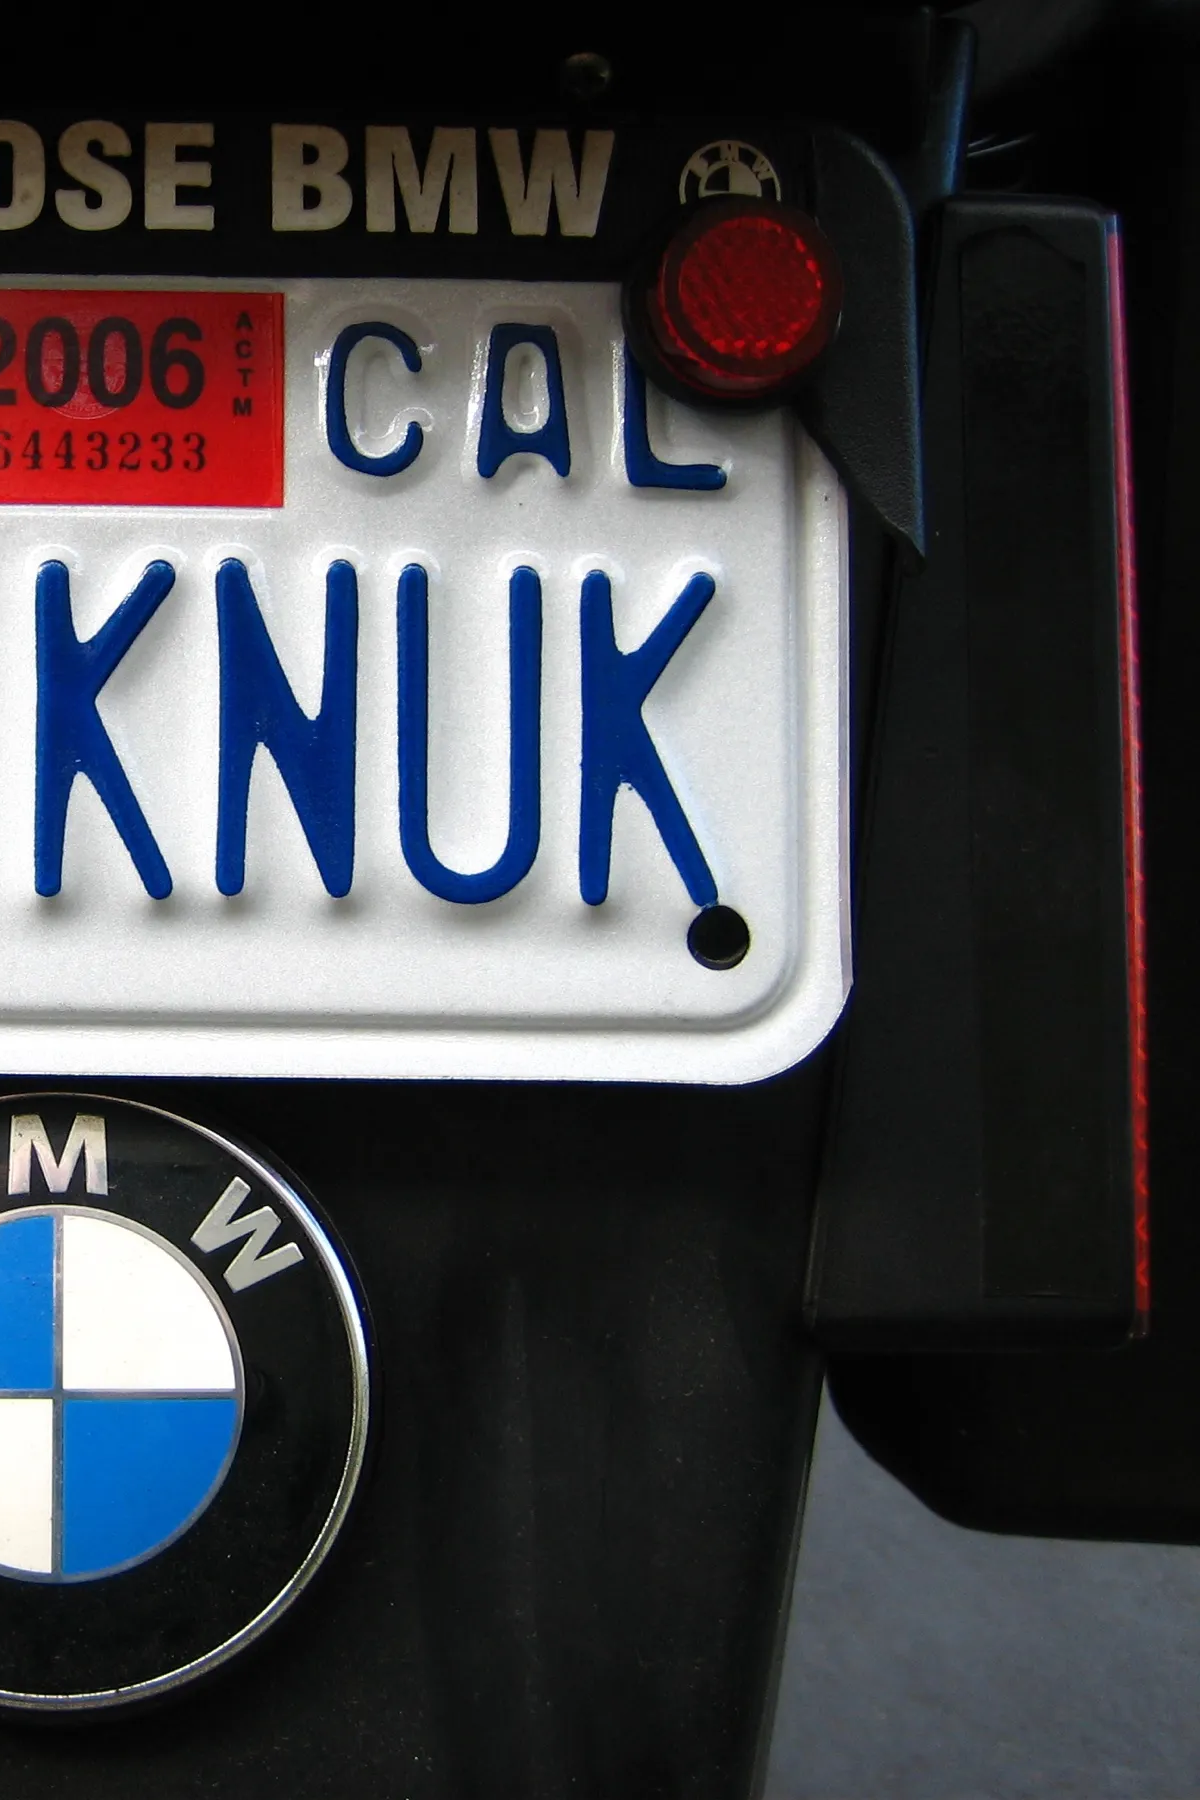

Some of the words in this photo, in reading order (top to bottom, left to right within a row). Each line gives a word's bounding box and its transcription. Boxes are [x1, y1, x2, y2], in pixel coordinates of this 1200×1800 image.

[271, 123, 616, 238] BMW
[326, 321, 728, 490] CAL
[34, 557, 719, 906] KNUK
